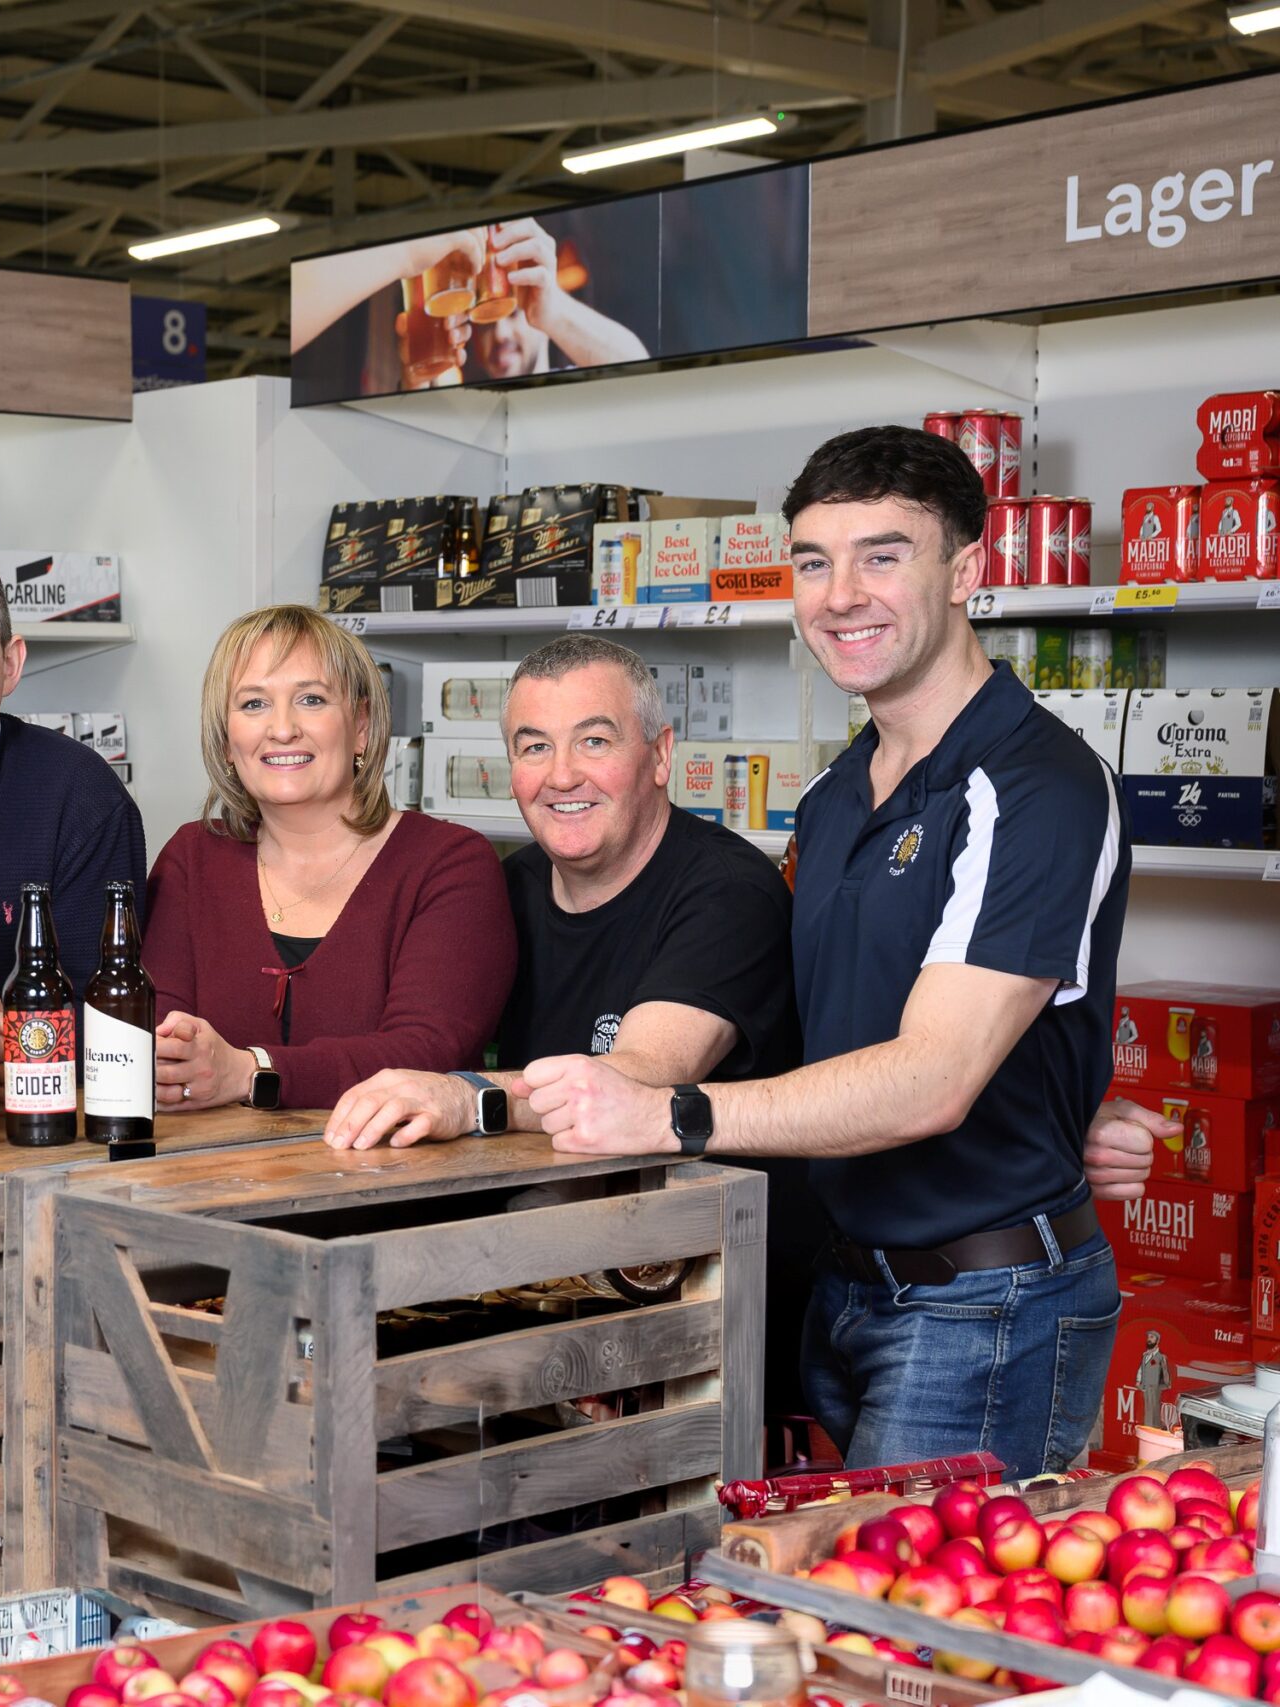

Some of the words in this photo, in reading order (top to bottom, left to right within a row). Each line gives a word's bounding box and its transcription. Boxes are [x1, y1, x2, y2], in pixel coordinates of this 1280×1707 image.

[1066, 159, 1274, 248] Lager
[162, 309, 187, 355] 8
[1209, 404, 1257, 434] MADRÍ
[736, 523, 762, 535] Best
[664, 536, 689, 548] Best
[728, 536, 769, 550] Served
[1128, 537, 1170, 563] MADRÍ
[1206, 532, 1250, 559] MADRÍ
[657, 549, 697, 563] Served
[724, 554, 740, 565] Ice
[745, 550, 772, 564] Cold
[1209, 557, 1246, 567] EXCEPCIONAL
[655, 565, 670, 577] Ice
[673, 563, 699, 576] Cold
[1131, 561, 1165, 571] EXCEPCIONAL
[716, 574, 748, 589] Cold
[750, 572, 783, 588] Beer
[5, 583, 66, 605] CARLING
[331, 585, 365, 612] Miller
[454, 578, 496, 606] Miller
[600, 585, 619, 596] Beer
[971, 594, 995, 615] 13
[593, 609, 618, 627] £4
[704, 605, 731, 625] £4
[1135, 700, 1142, 710] 4
[1157, 722, 1227, 748] Corona
[1247, 723, 1262, 731] WIN
[96, 737, 123, 748] CARLING
[1174, 743, 1211, 758] Extra
[686, 761, 714, 775] Cold
[686, 777, 713, 791] Beer
[725, 786, 746, 798] Cold
[726, 799, 746, 810] Beer
[21, 1025, 31, 1046] LONG
[31, 1021, 55, 1046] MEADOW
[85, 1047, 134, 1067] Heaney.
[1191, 1055, 1218, 1074] MADRÍ
[1114, 1067, 1144, 1078] CEPCIONAL
[15, 1075, 62, 1096] CIDER
[1184, 1147, 1211, 1165] MADRÍ
[1123, 1197, 1194, 1239] MADRÍ
[1129, 1231, 1187, 1252] EXCEPCIONAL
[1260, 1278, 1271, 1294] 12
